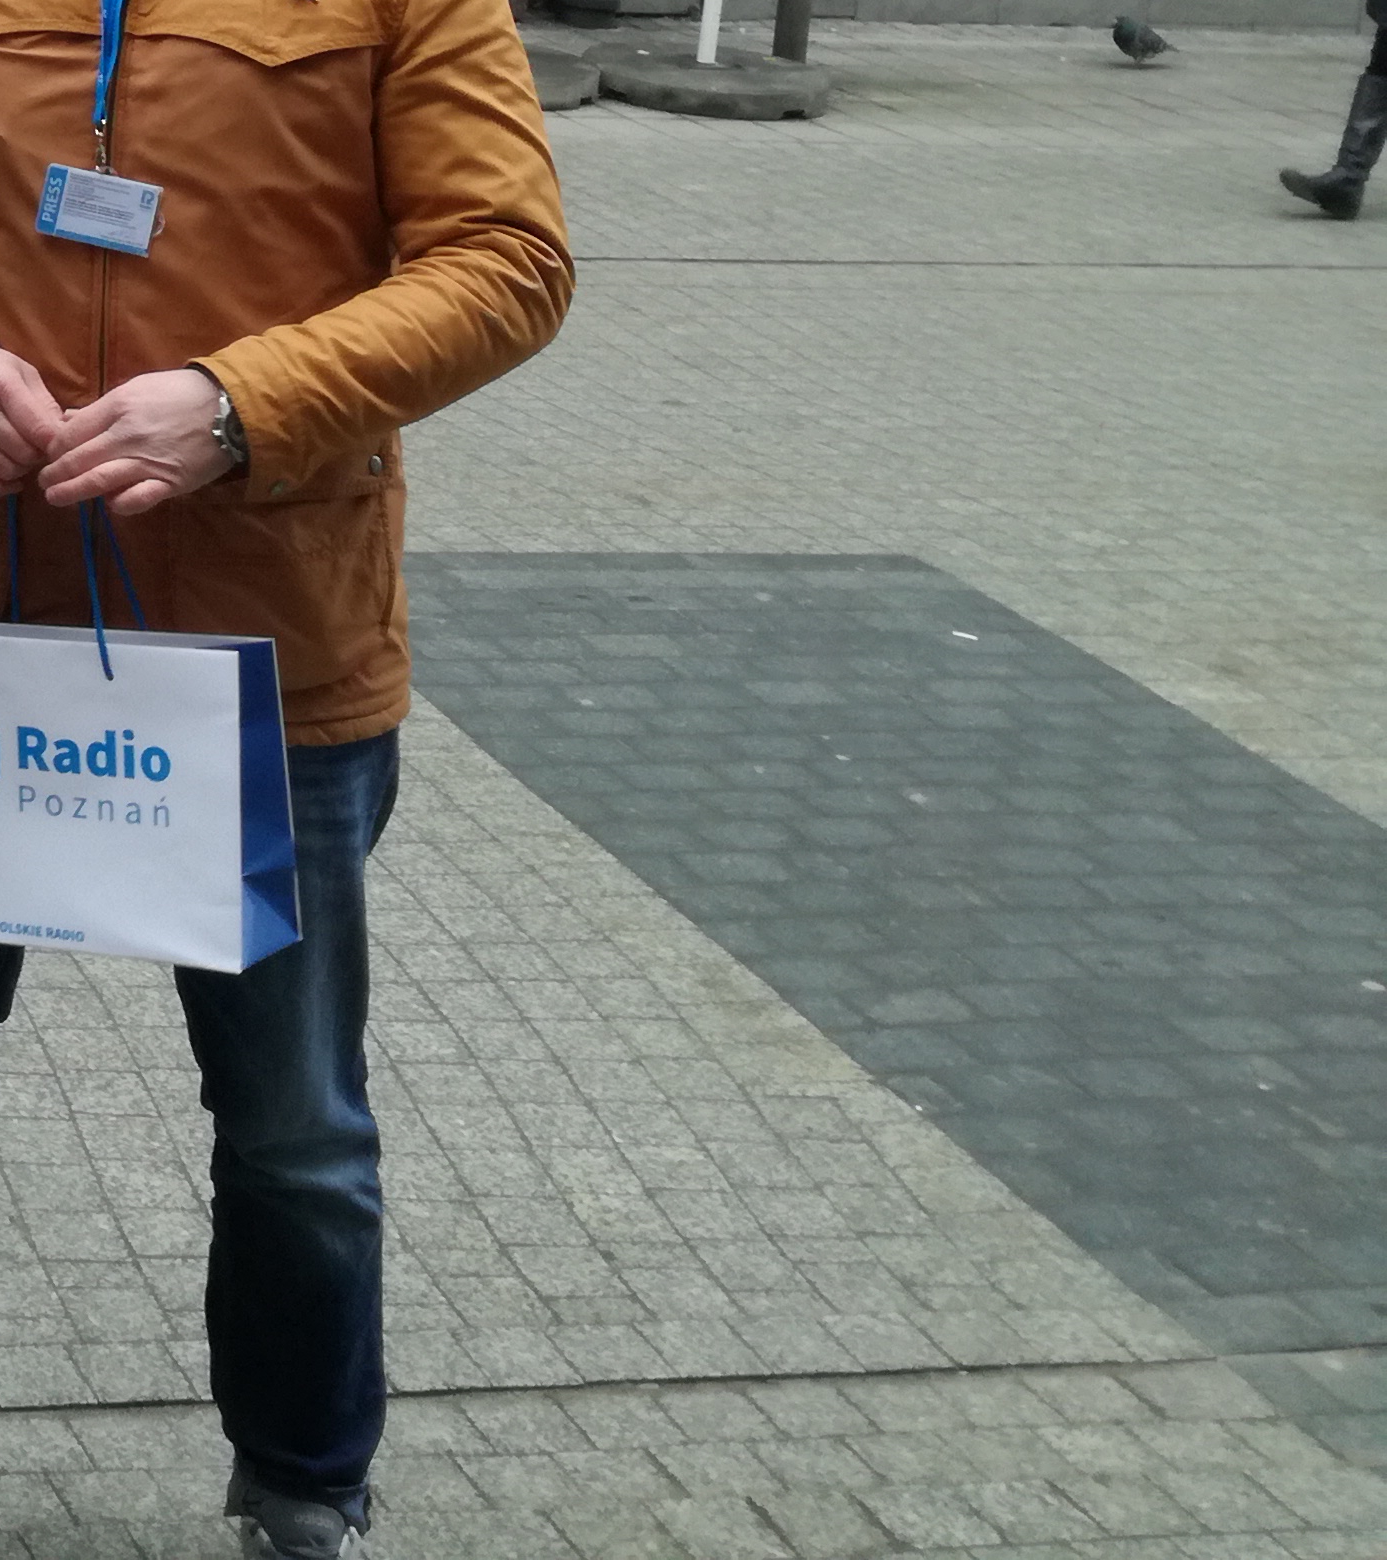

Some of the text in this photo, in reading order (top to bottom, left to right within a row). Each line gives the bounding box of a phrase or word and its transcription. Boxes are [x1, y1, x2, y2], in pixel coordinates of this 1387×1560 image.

[41, 176, 62, 223] PRESS
[16, 725, 171, 782] Radio
[18, 785, 170, 828] Poznań
[45, 926, 85, 942] RADIO
